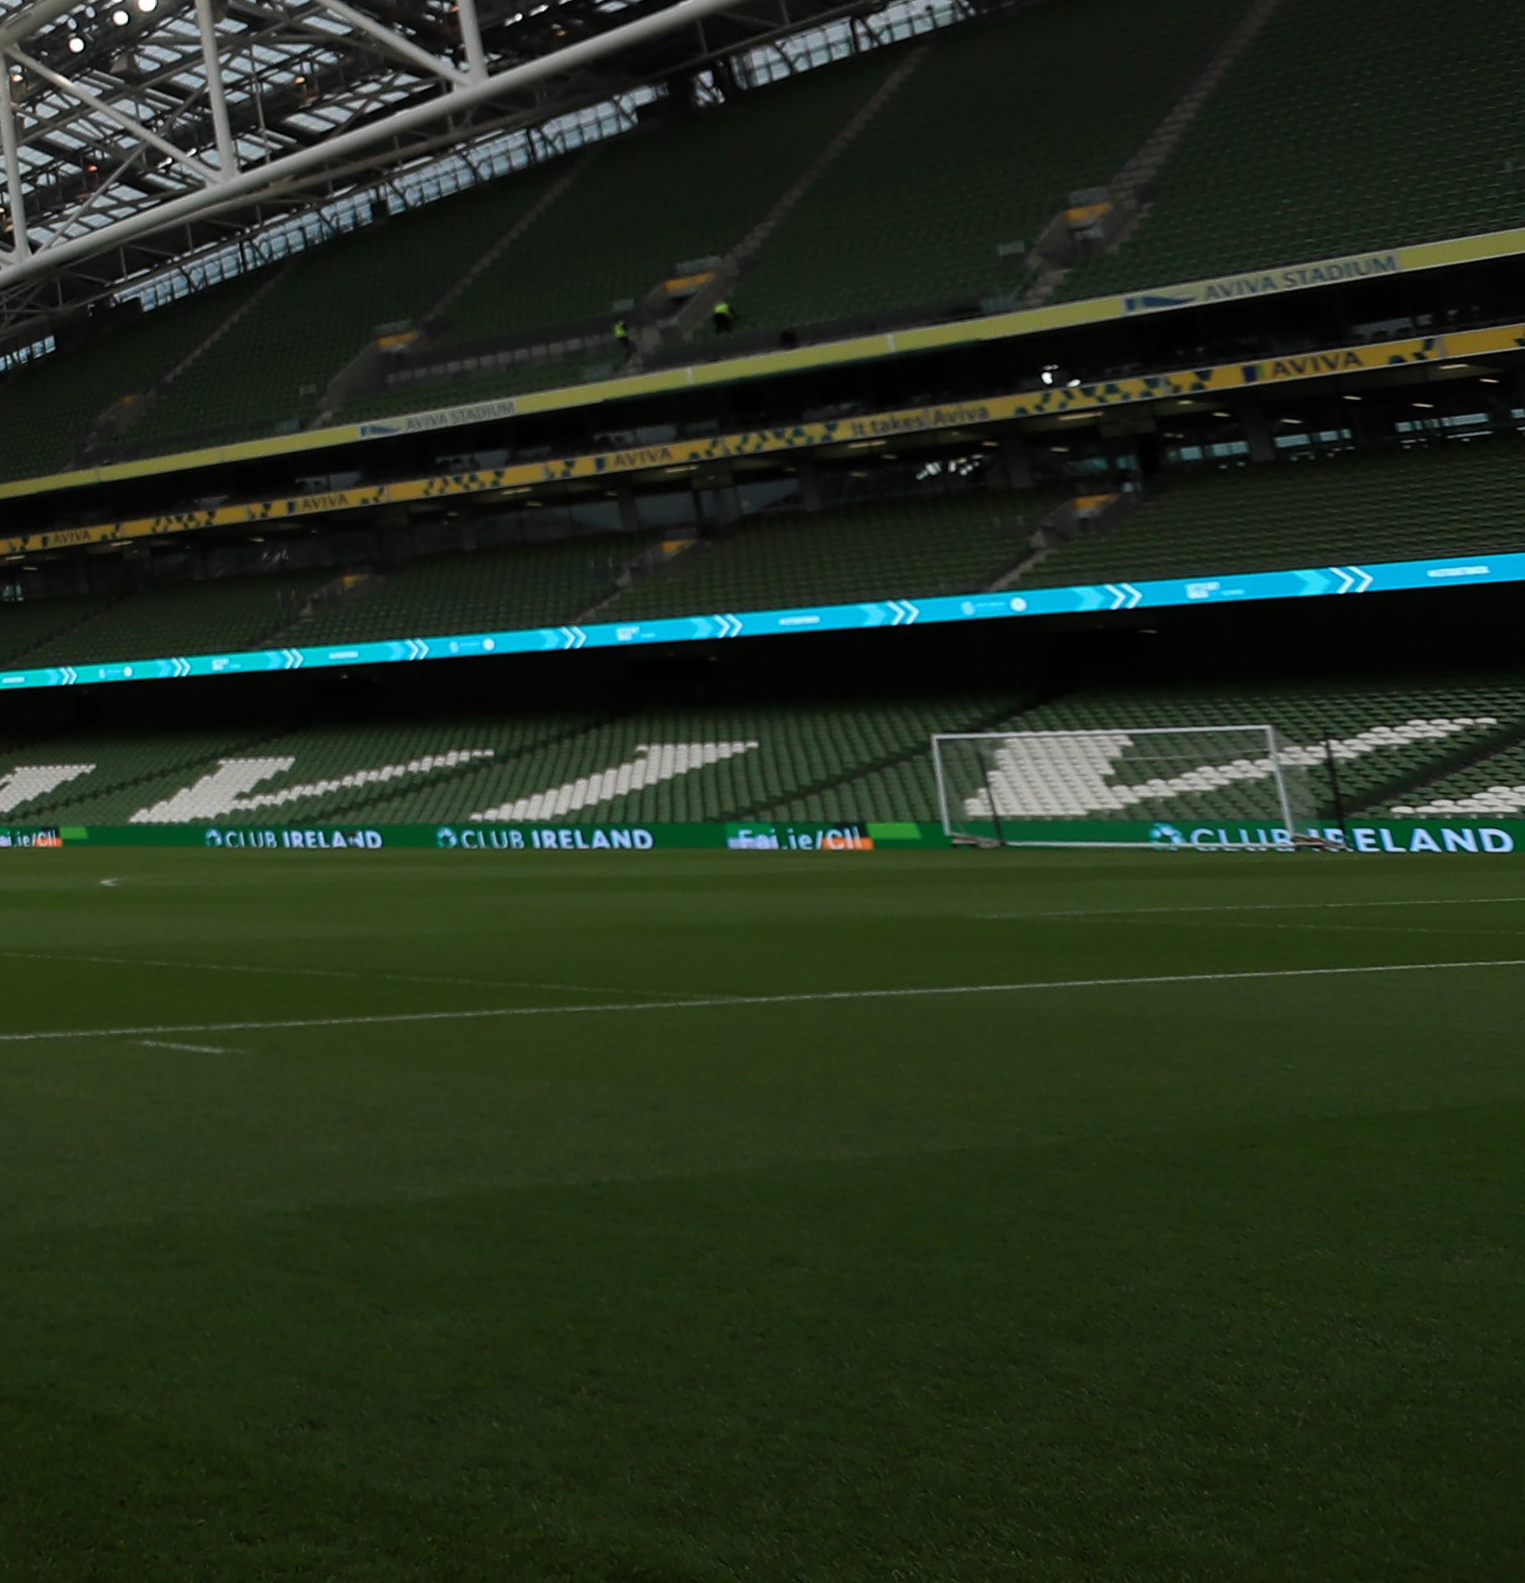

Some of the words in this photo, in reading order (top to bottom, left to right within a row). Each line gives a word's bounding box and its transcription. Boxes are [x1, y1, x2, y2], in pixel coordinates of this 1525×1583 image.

[1205, 275, 1278, 302] AVIVA
[1284, 254, 1398, 288] STADIUM
[1271, 350, 1364, 378] AVIVA
[406, 413, 447, 432] AVIVA
[451, 400, 516, 424] STADIUM
[613, 446, 674, 468] AVIVA
[301, 493, 348, 512] AVIVA
[53, 530, 91, 545] AVIVA
[224, 830, 277, 848] CLUB
[282, 830, 383, 849] IRELAND
[460, 829, 525, 849] CLUB
[530, 829, 654, 850] IRELAND
[1189, 828, 1295, 851] CLUB
